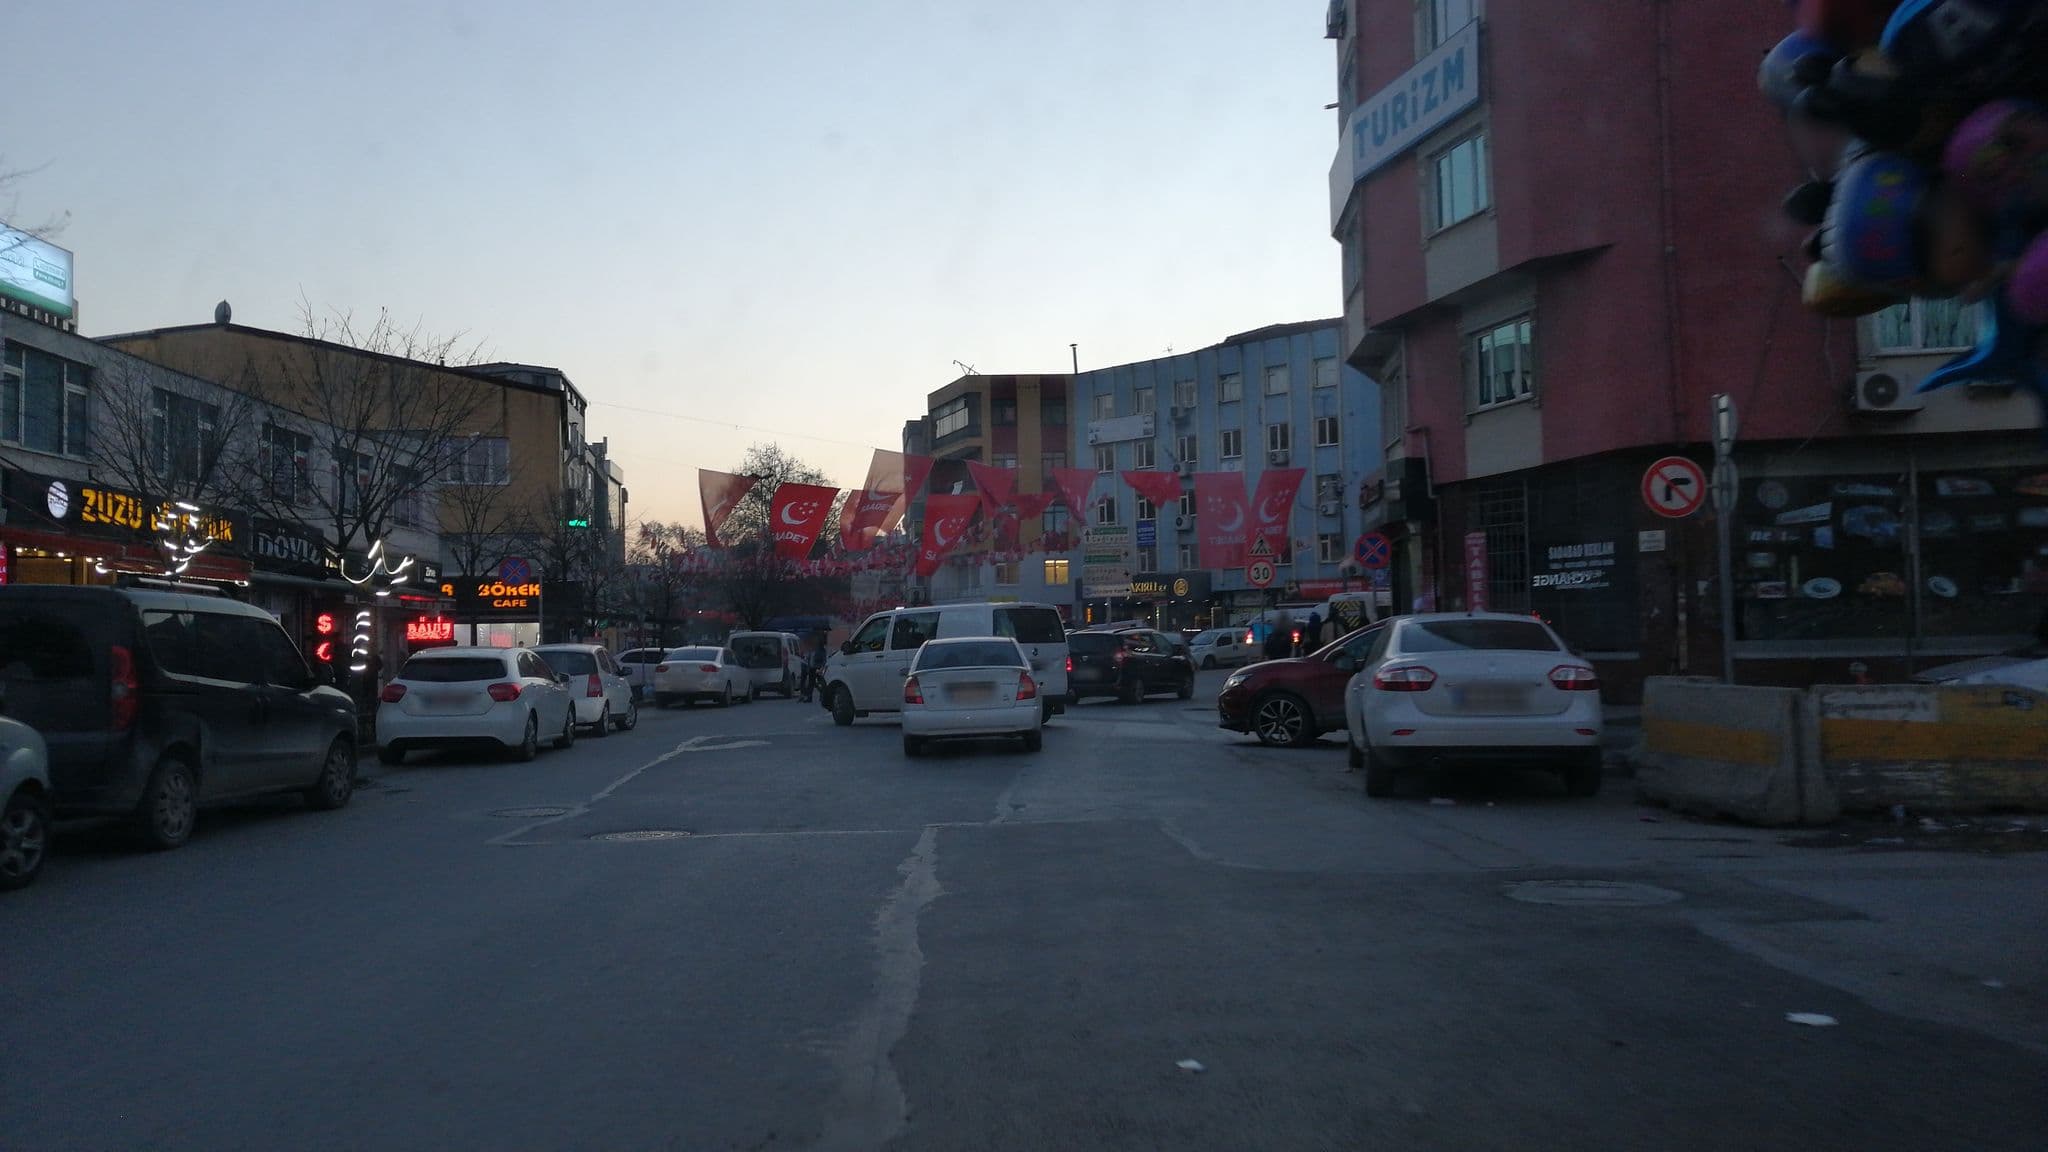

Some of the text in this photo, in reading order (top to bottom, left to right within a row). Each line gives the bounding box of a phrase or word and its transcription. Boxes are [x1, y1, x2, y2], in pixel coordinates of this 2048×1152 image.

[1355, 47, 1464, 158] TURİZM
[80, 488, 143, 530] ZUZU
[1253, 567, 1270, 580] 30
[492, 600, 527, 609] CAFE
